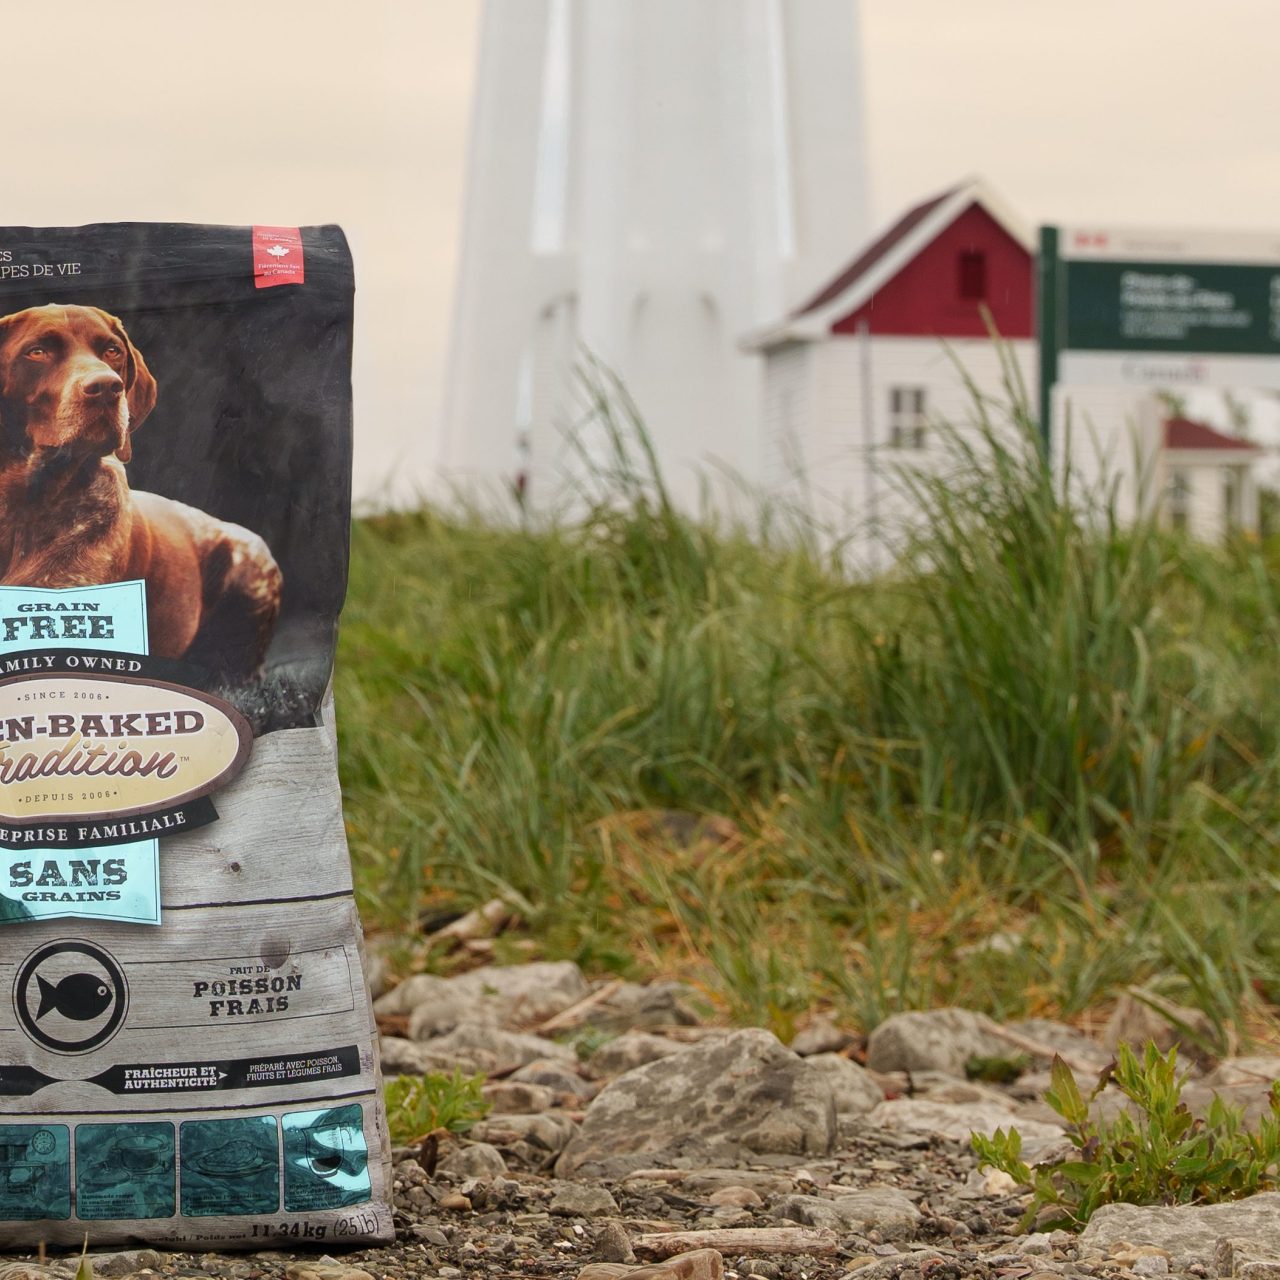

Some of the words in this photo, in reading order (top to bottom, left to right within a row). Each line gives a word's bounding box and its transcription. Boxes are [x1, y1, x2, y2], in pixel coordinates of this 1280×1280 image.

[33, 264, 54, 276] DE
[57, 263, 82, 275] VIE
[17, 602, 100, 613] GRAIN
[2, 615, 115, 642] FREE
[65, 655, 142, 672] OWNED
[24, 691, 66, 701] SINCE
[73, 692, 102, 701] 2006
[24, 792, 74, 803] DEPUIS
[82, 790, 111, 801] 2006
[78, 811, 187, 841] FAMILIALE
[9, 858, 128, 888] SANS
[21, 890, 121, 903] GRAINS
[229, 966, 253, 975] FAIT
[256, 965, 271, 974] DE
[193, 974, 302, 998] POISSON
[209, 996, 289, 1017] FRAIS
[124, 1067, 200, 1079] FRAÎCHEUR
[201, 1067, 217, 1077] ET
[246, 1072, 275, 1081] FRUITS
[276, 1070, 287, 1079] ET
[287, 1066, 321, 1078] LÉGUMES
[322, 1063, 343, 1074] FRAIS
[249, 1061, 285, 1073] PRÉPARÉ
[285, 1060, 306, 1070] AVEC
[124, 1075, 217, 1089] AUTHENTICITÉ
